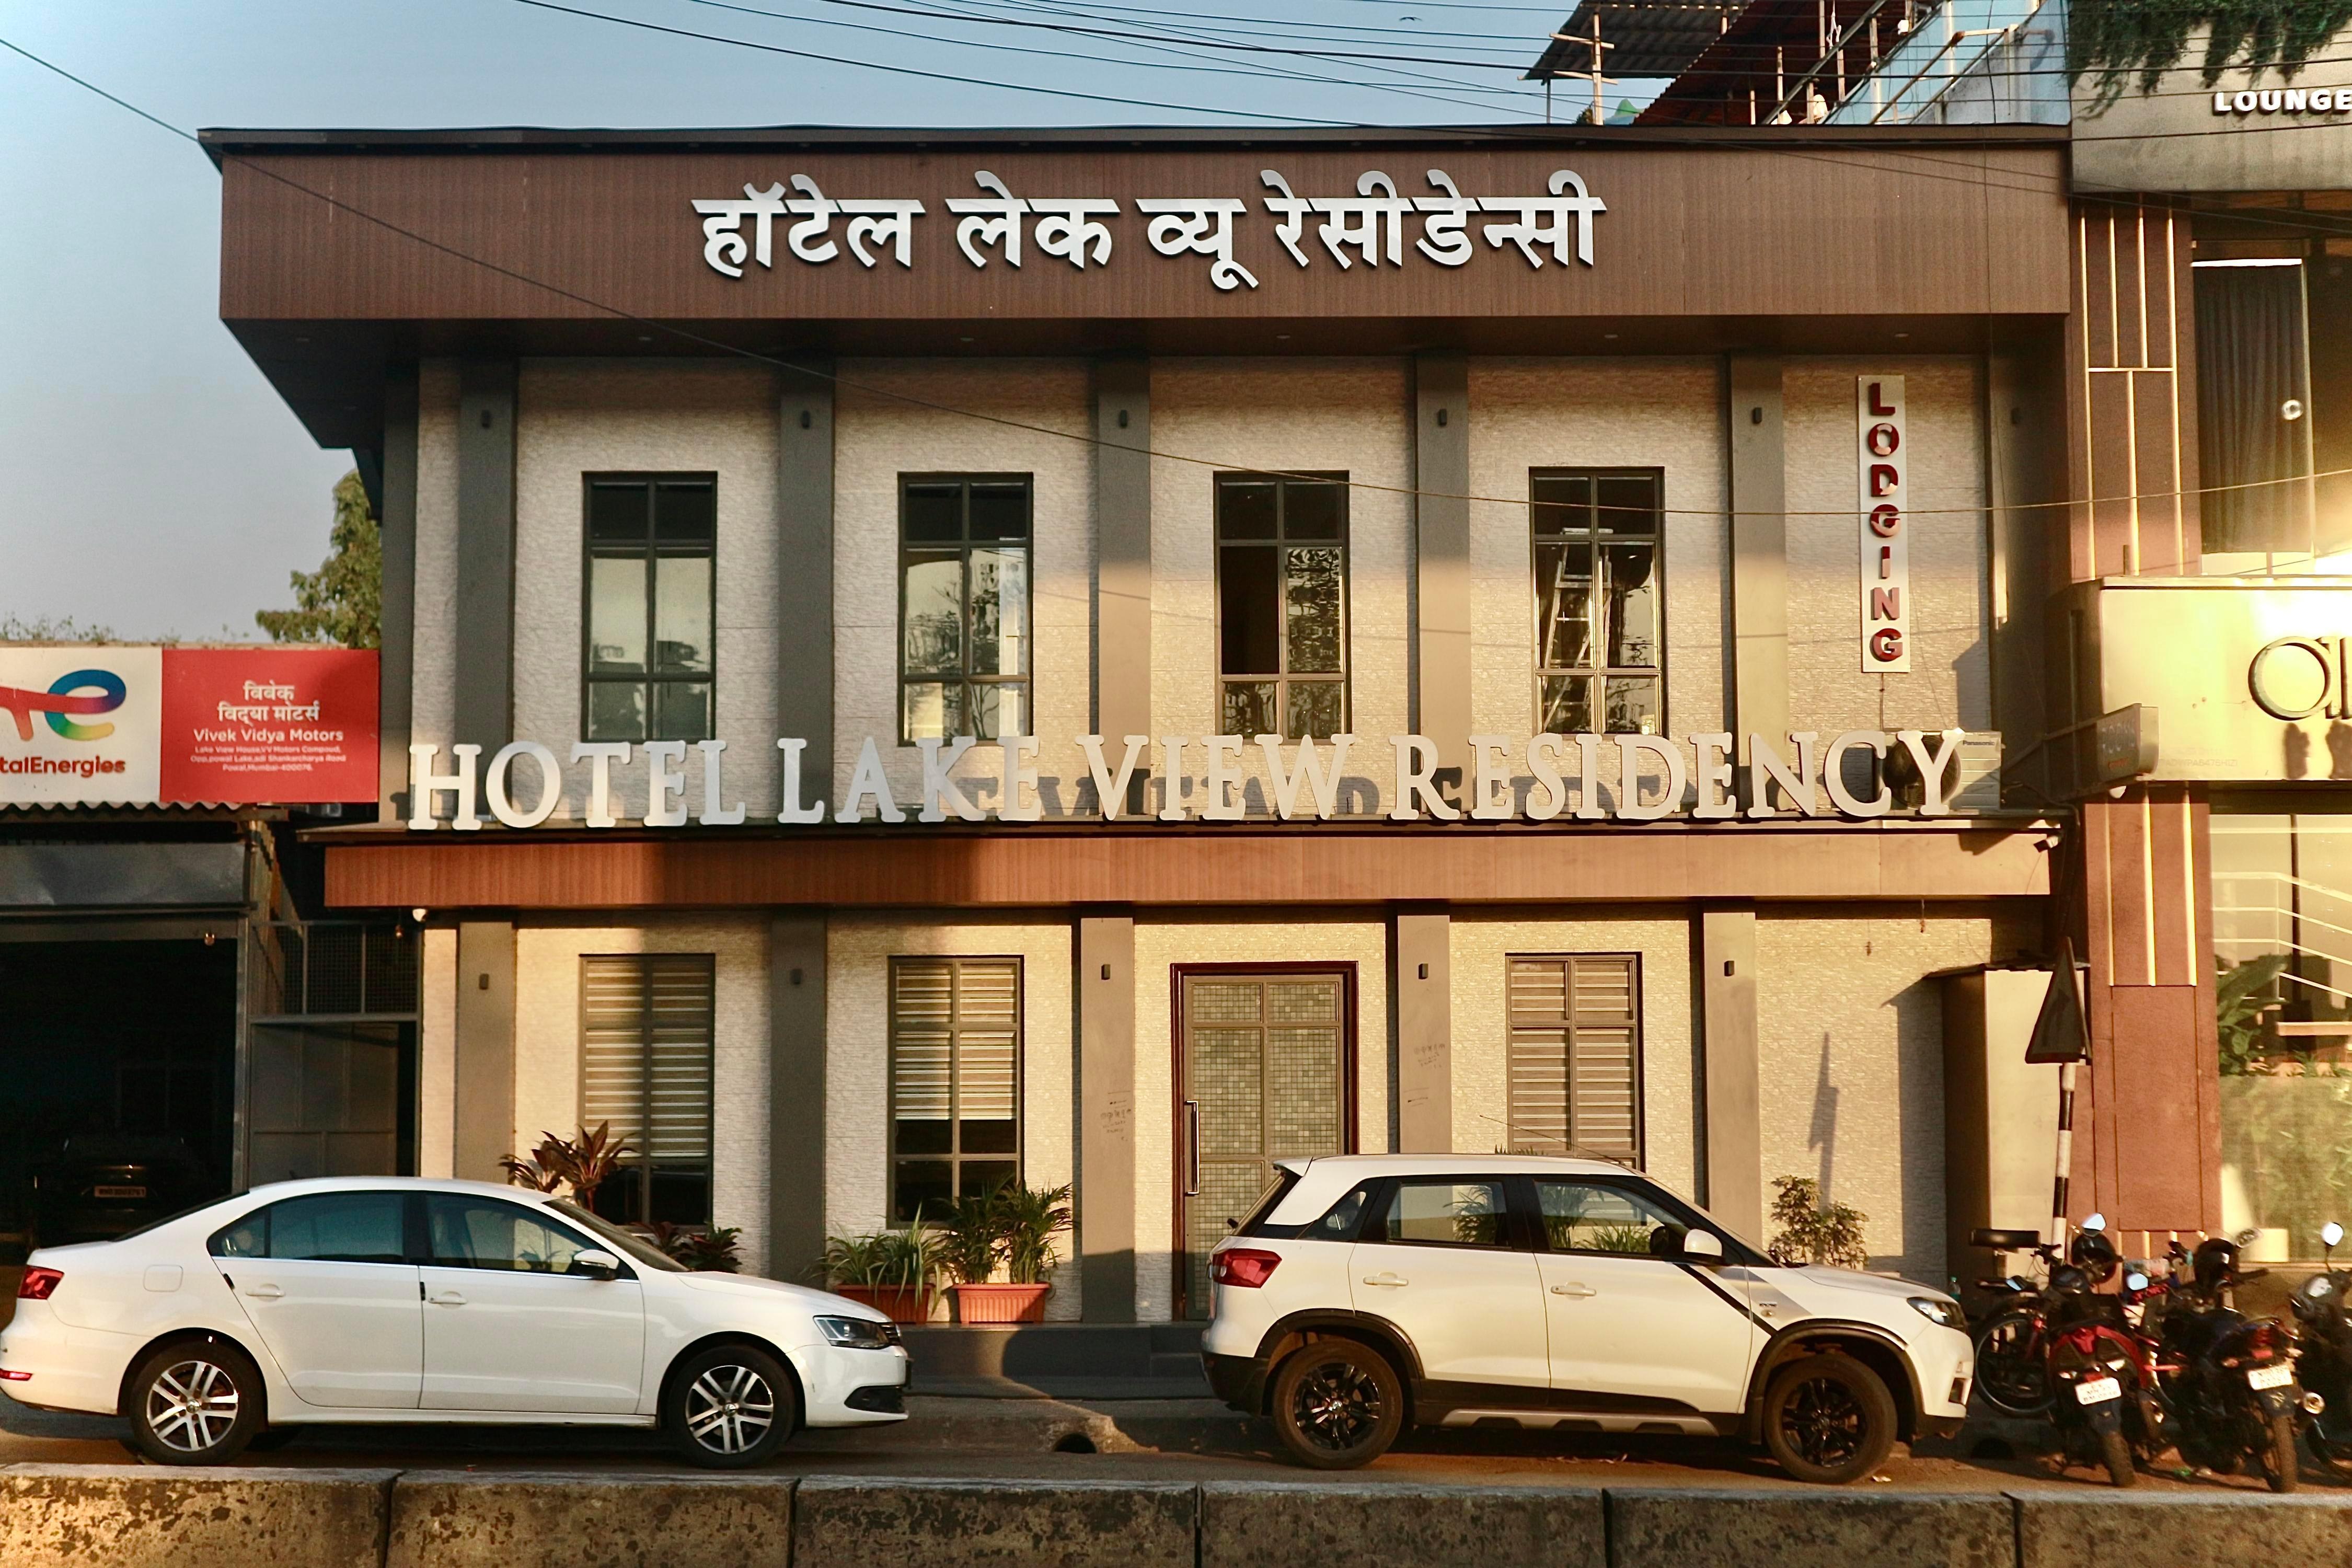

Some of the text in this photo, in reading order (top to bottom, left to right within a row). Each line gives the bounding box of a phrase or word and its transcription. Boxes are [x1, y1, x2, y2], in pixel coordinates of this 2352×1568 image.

[2215, 88, 2352, 112] LOUNGE
[691, 169, 1608, 290] हॉटेल लेक व्यू रेसीडेन्सी
[1867, 382, 1904, 662] LODGING
[243, 679, 295, 701] विवेक
[271, 700, 320, 722] मोटर्स
[193, 728, 344, 744] Vivek Vidya Motors
[408, 730, 1964, 831] HOTEL LAKE VIEW RESIDENCY
